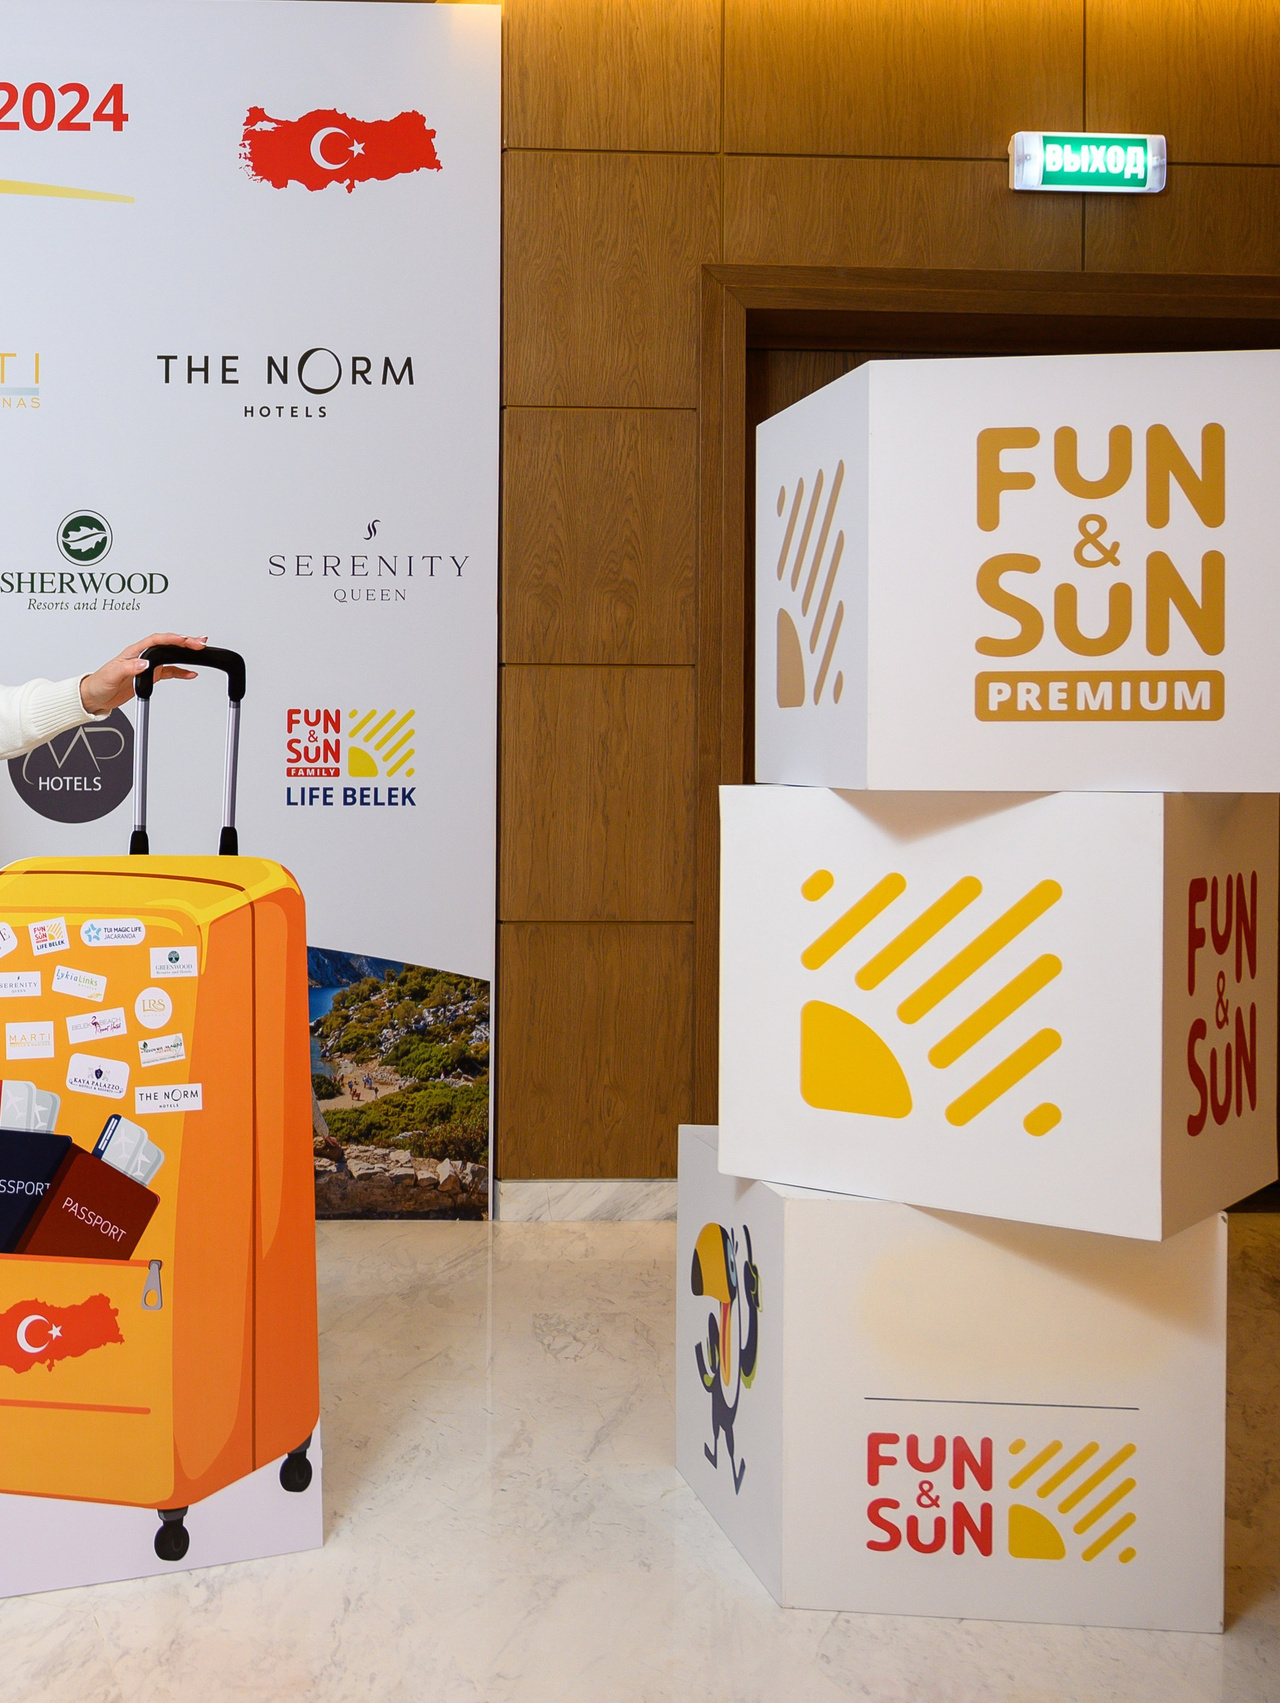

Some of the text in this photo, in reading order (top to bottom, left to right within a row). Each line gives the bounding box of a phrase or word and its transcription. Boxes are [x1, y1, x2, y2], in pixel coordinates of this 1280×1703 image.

[1046, 144, 1145, 179] ВЫХОД
[157, 347, 415, 395] THE NORM
[244, 405, 327, 418] HOTELS
[976, 423, 1225, 532] FUN
[1074, 514, 1120, 568] &
[268, 555, 469, 577] SERENITY
[0, 572, 169, 595] SHERWOOD
[333, 589, 407, 603] QUEEN
[27, 599, 140, 611] Resorts and Hotels
[975, 550, 1225, 657] SUN
[988, 681, 1210, 711] PREMIUM
[286, 708, 341, 735] FUN
[308, 730, 318, 743] &
[286, 738, 341, 764] SUN
[38, 776, 102, 792] HOTELS
[290, 768, 336, 776] FAMILY
[286, 787, 416, 806] LIFE BELEK
[33, 925, 46, 934] FUN
[1188, 870, 1257, 996] FUN
[36, 943, 48, 951] LIFE
[48, 940, 65, 948] BELEK
[1216, 970, 1229, 1029] &
[9, 1033, 51, 1042] MARTI
[1187, 1002, 1256, 1136] SUN
[73, 1077, 90, 1086] KAYA
[91, 1080, 120, 1091] PALAZZO
[138, 1088, 199, 1102] THE NORM
[62, 1196, 127, 1243] PASSPORT
[867, 1432, 992, 1491] FUN
[916, 1480, 940, 1509] &
[866, 1497, 992, 1557] SUN
